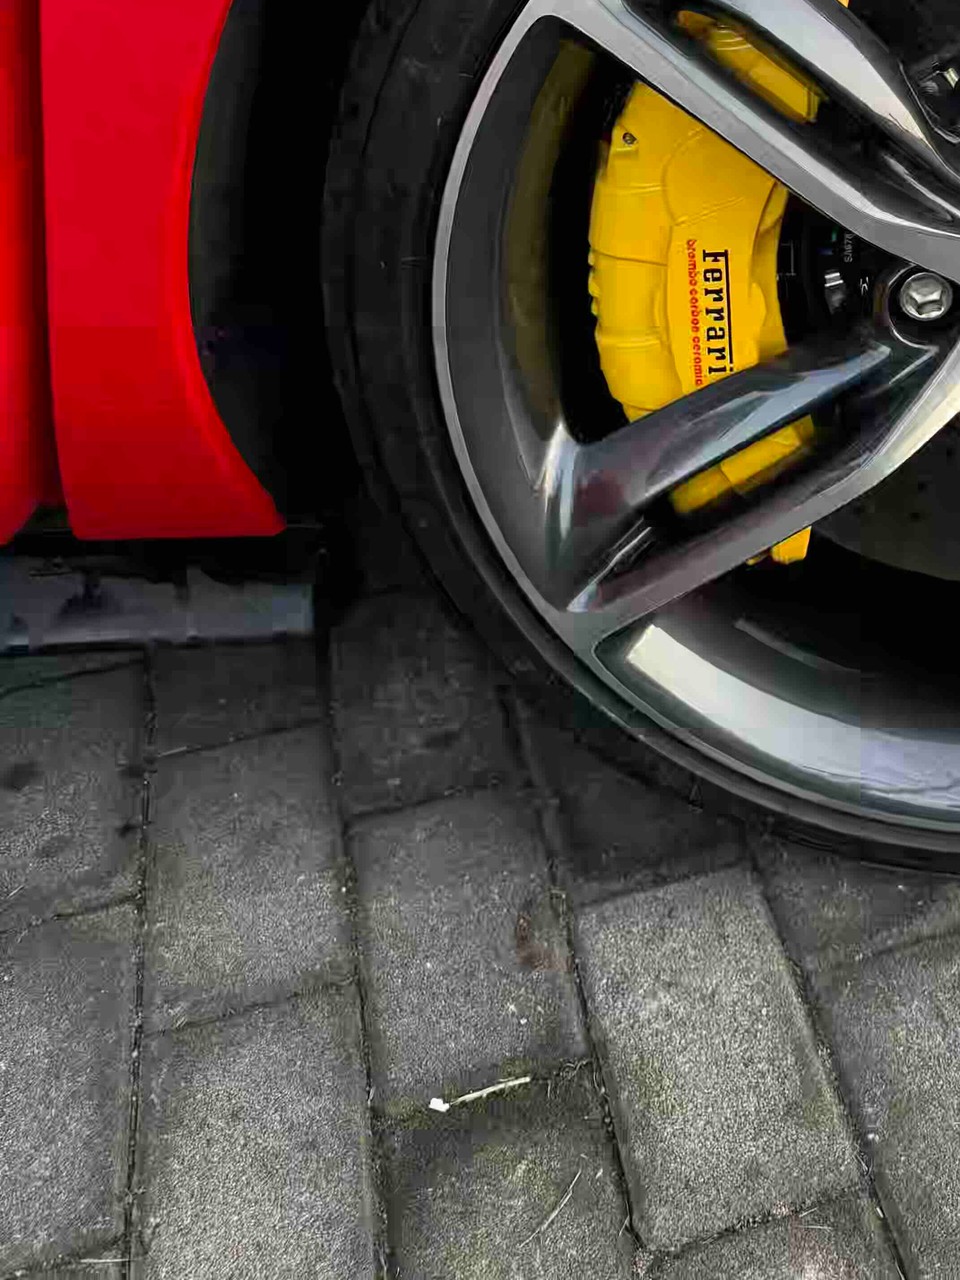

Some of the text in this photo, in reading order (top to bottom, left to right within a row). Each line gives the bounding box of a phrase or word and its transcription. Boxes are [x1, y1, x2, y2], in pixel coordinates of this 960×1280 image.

[686, 239, 703, 386] brembo carbon ceramic
[702, 249, 734, 375] Ferrari
